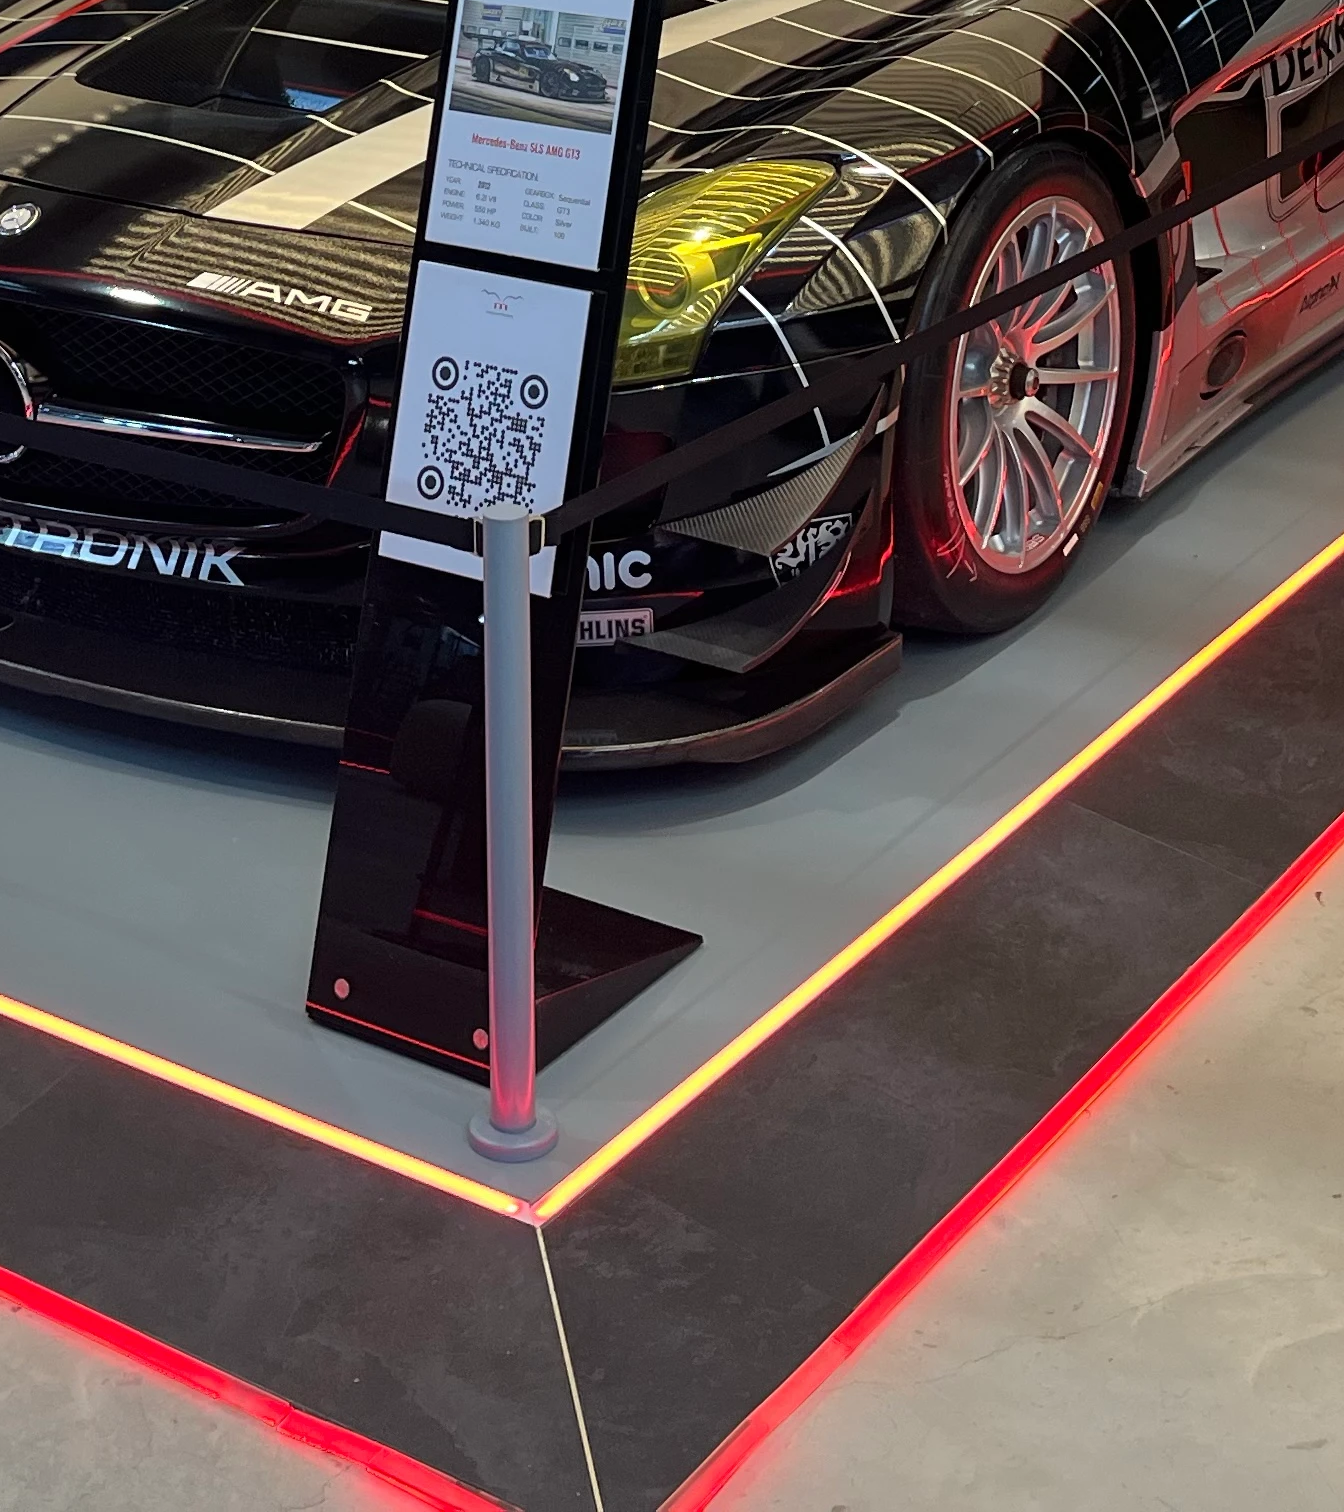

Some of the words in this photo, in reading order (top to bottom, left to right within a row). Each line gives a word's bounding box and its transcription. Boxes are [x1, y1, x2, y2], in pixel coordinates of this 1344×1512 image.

[472, 133, 528, 152] Mercedes-Benz
[530, 142, 544, 155] SLS
[546, 145, 563, 158] AMG
[565, 148, 581, 161] GT3
[240, 280, 372, 323] AMG
[579, 618, 646, 641] HLINS
